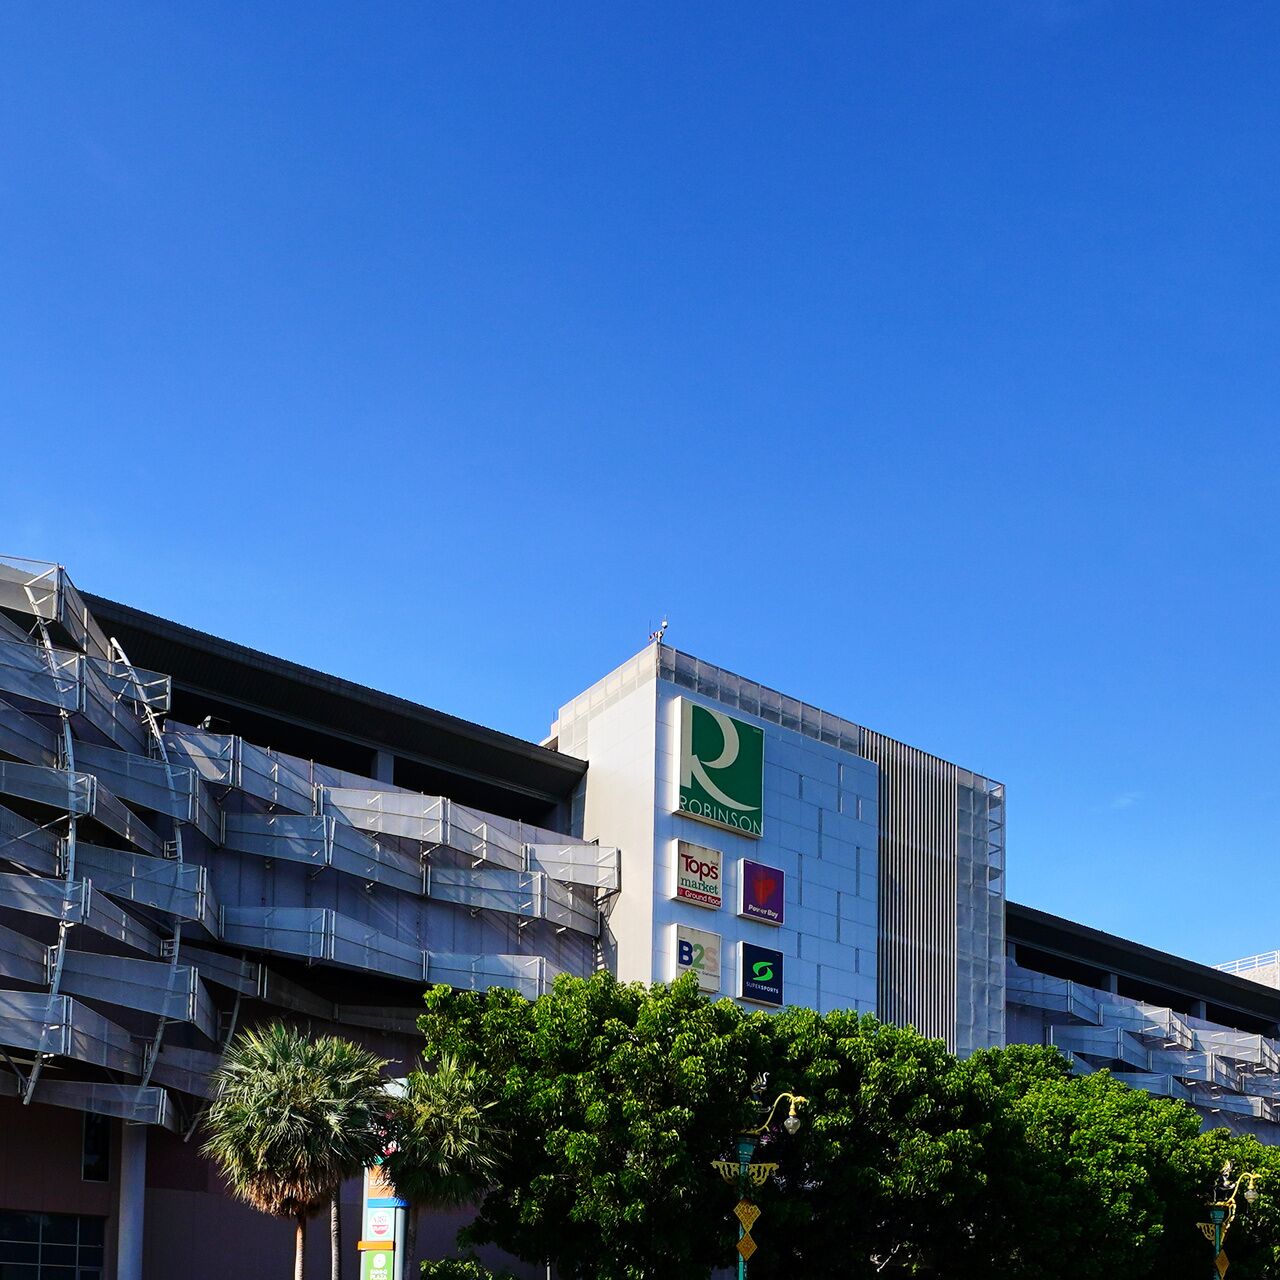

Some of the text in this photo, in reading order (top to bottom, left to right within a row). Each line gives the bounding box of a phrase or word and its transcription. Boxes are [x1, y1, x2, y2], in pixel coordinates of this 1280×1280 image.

[680, 795, 762, 835] ROBINSON
[681, 853, 719, 881] Tops
[680, 877, 719, 896] market
[685, 889, 708, 903] Ground
[678, 939, 719, 973] B2S
[746, 981, 779, 994] SUPERSPORTS
